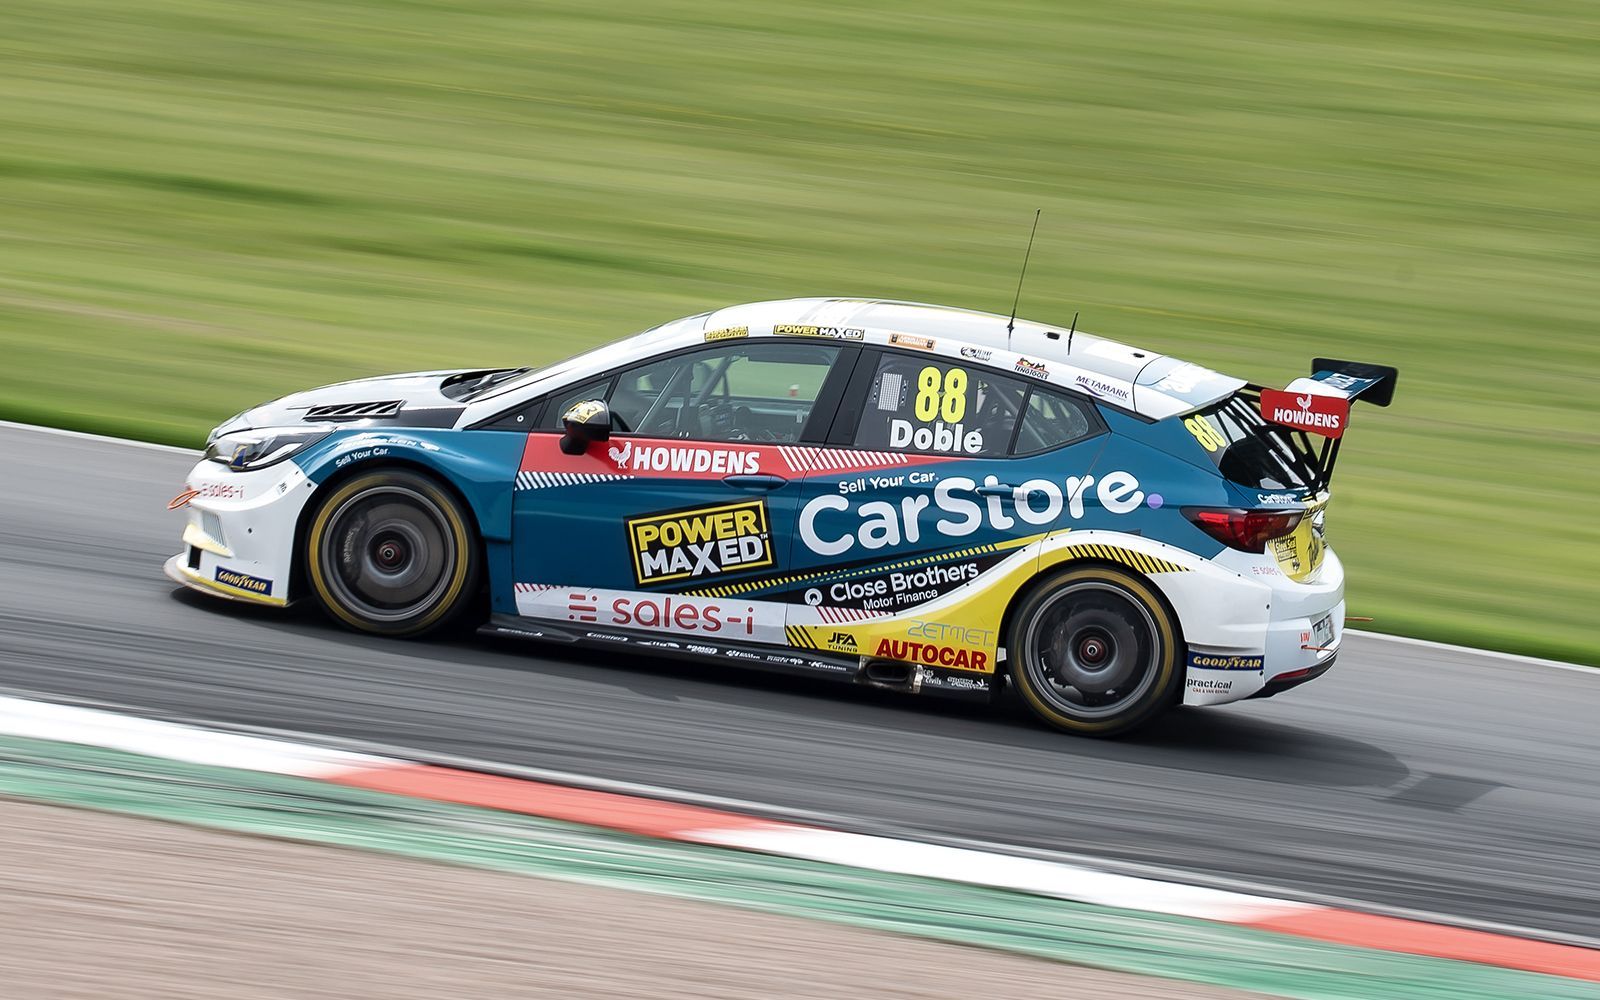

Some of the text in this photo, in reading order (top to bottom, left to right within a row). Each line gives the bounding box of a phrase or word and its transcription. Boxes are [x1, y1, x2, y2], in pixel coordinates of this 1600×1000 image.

[776, 324, 862, 339] POWER MAXED
[915, 366, 968, 424] 88
[1075, 375, 1130, 399] METAMARK
[1273, 408, 1340, 429] HOWDENS
[889, 419, 983, 453] Doble
[1183, 414, 1227, 452] 88
[335, 453, 351, 468] Sell
[351, 450, 371, 460] Your
[633, 447, 761, 475] HOWDENS
[838, 480, 866, 494] Sell
[869, 473, 905, 489] Your
[636, 509, 760, 552] POWER
[640, 535, 764, 577] MAXED
[218, 571, 268, 591] GOODYEAR
[830, 561, 979, 602] Close Brothers
[862, 587, 939, 611] Motor Finance
[612, 597, 754, 635] sales-i
[827, 632, 858, 646] JFA
[907, 620, 994, 646] ZETMET
[827, 645, 857, 653] TUNING
[875, 638, 987, 671] AUTOCAR
[1193, 656, 1262, 669] GOODYEAR
[1186, 677, 1233, 689] practical
